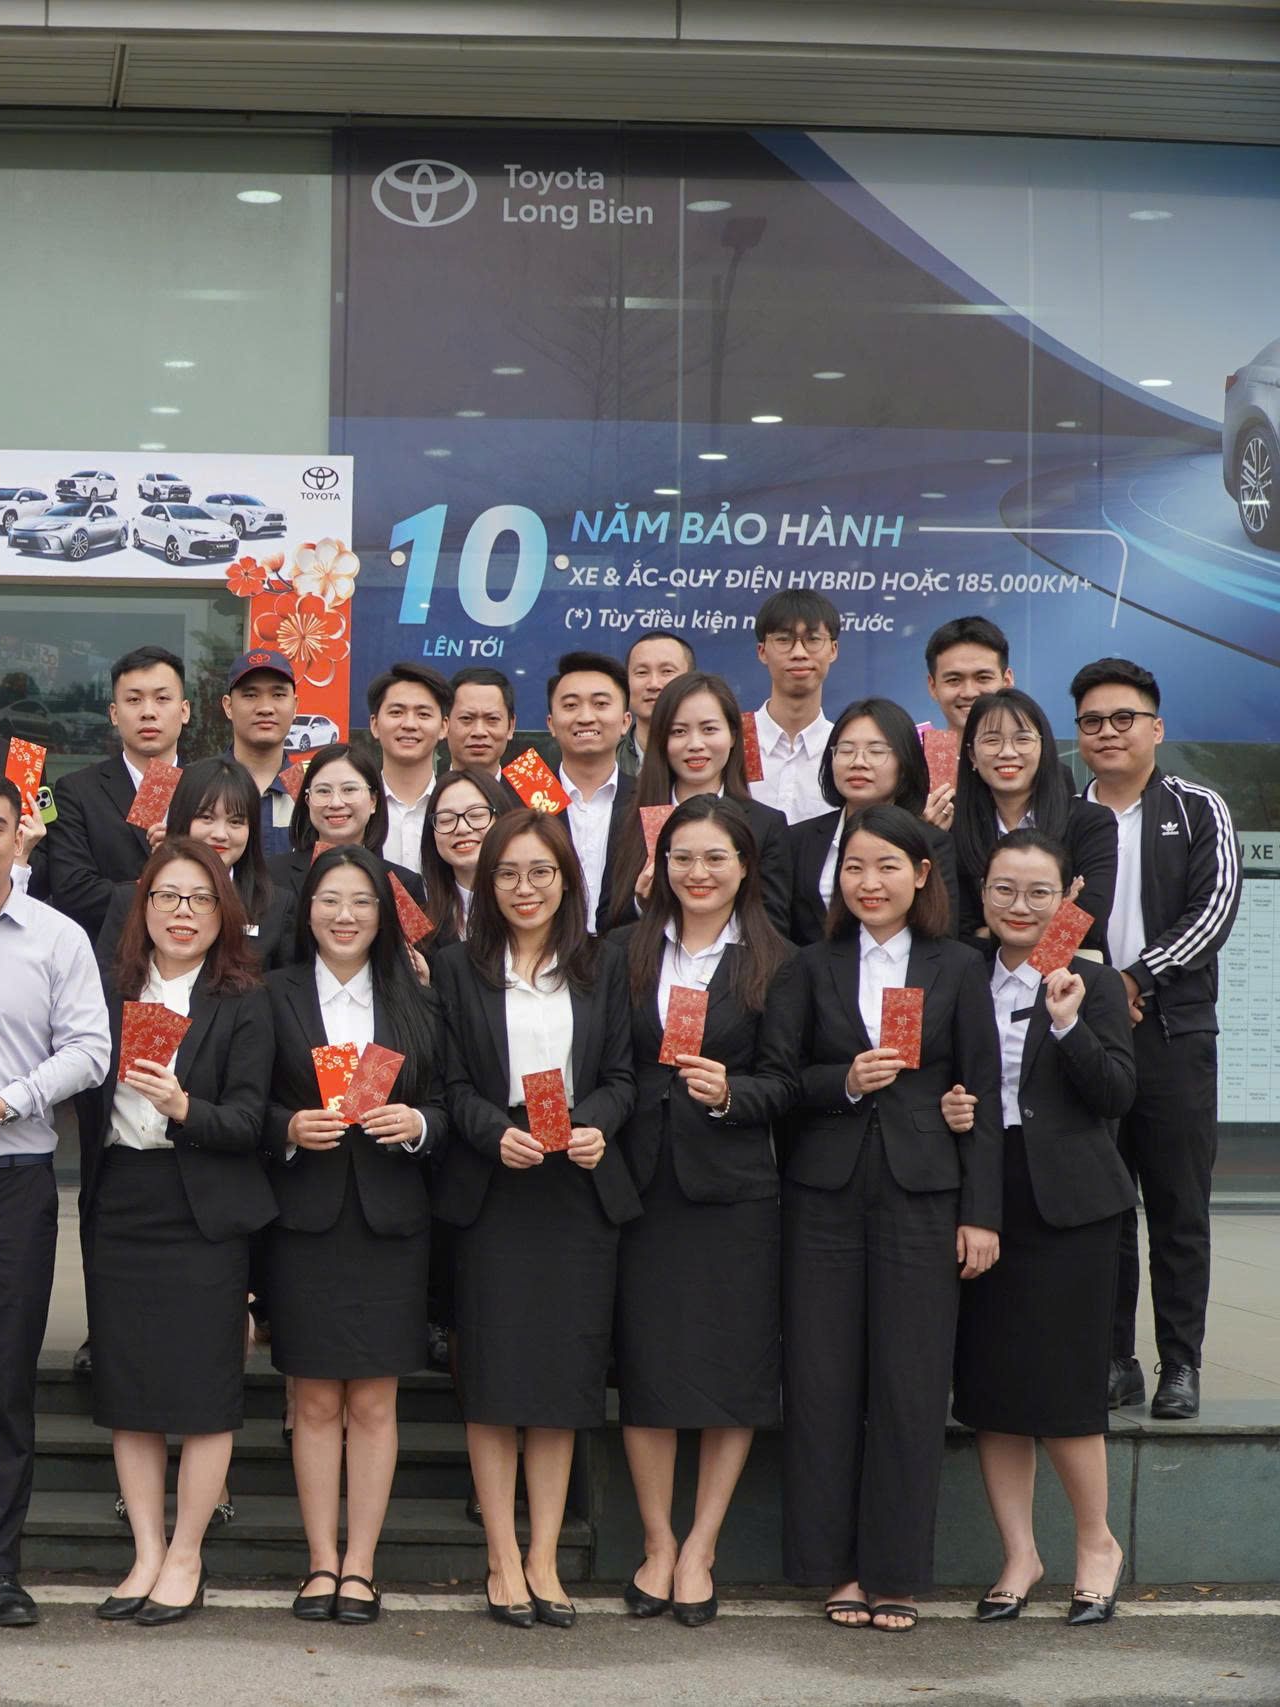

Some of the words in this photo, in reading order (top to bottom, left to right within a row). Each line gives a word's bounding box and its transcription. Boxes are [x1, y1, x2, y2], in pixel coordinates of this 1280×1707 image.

[504, 164, 604, 196] Toyota
[503, 197, 579, 230] Long
[588, 198, 654, 225] Bien
[300, 491, 341, 501] TOYOTA
[570, 502, 671, 545] NĂM
[679, 501, 768, 546] BẢO
[778, 505, 905, 548] HÀNH
[389, 503, 549, 628] 10
[568, 566, 600, 586] XE
[603, 566, 621, 586] &
[625, 559, 722, 588] ẮC-QUY
[725, 564, 783, 594] ĐIỆN
[787, 570, 877, 592] HYBRID
[880, 567, 951, 596] HOẶC
[956, 572, 1093, 594] 185.000KM+
[598, 608, 635, 632] Tùy
[639, 607, 686, 629] điều
[691, 609, 738, 633] kiện
[422, 635, 465, 657] LÊN
[469, 635, 505, 658] TỚI
[1251, 844, 1274, 860] XE
